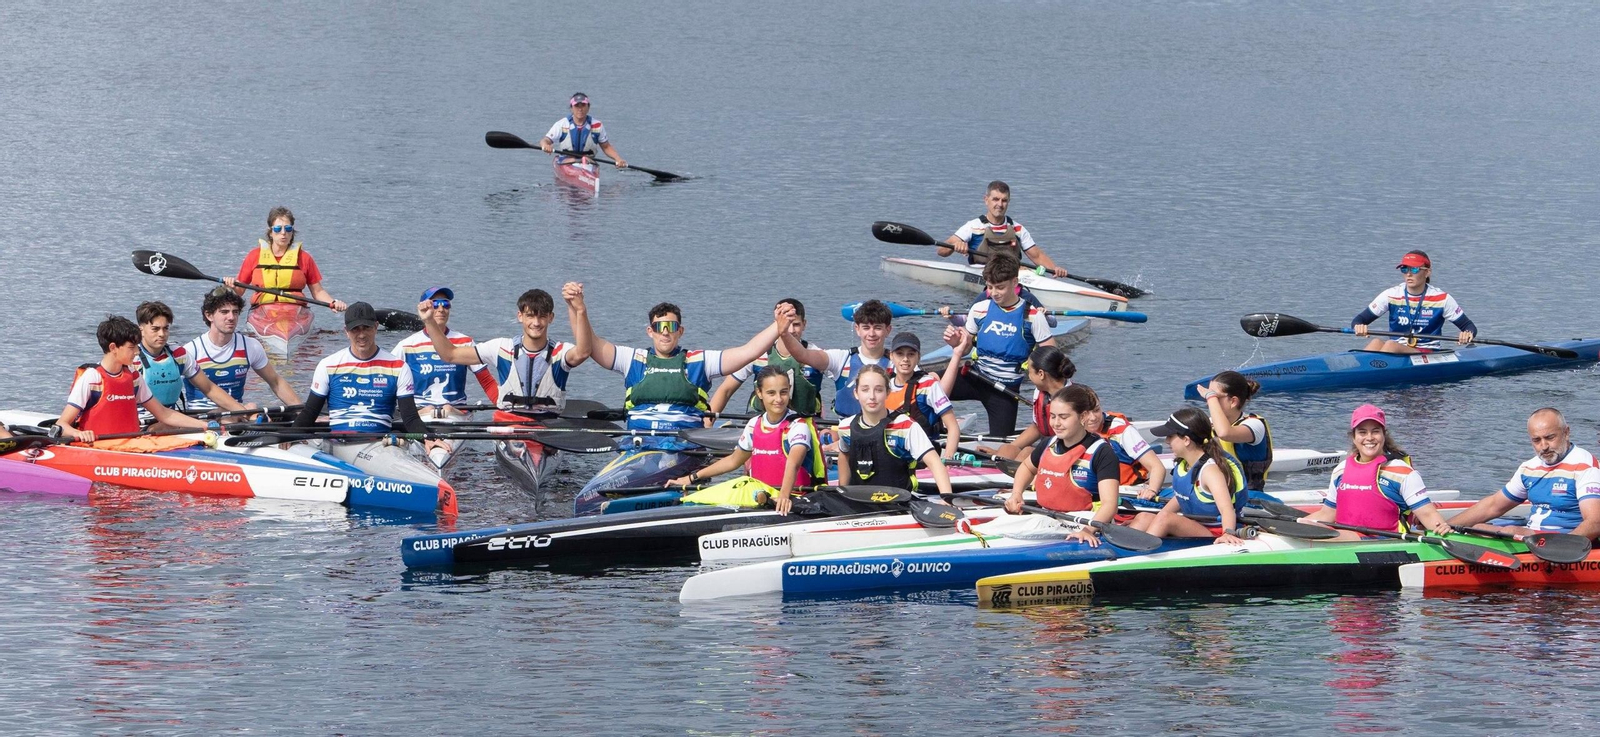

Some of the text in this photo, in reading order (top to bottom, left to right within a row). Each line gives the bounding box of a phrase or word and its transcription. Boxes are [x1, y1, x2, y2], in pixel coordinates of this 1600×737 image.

[94, 466, 241, 483] CLUB PIRAGÜISMO OLIVICO
[293, 477, 344, 488] ELIO
[376, 481, 413, 494] OLIVICO
[413, 539, 440, 551] CLUB
[702, 535, 789, 550] CLUB PIRAGÜISM
[787, 562, 951, 576] CLUB PIRAGÜISMO OLIVICO
[1435, 565, 1466, 576] CLUB
[1017, 581, 1094, 597] CLUB PIRAGÜIS
